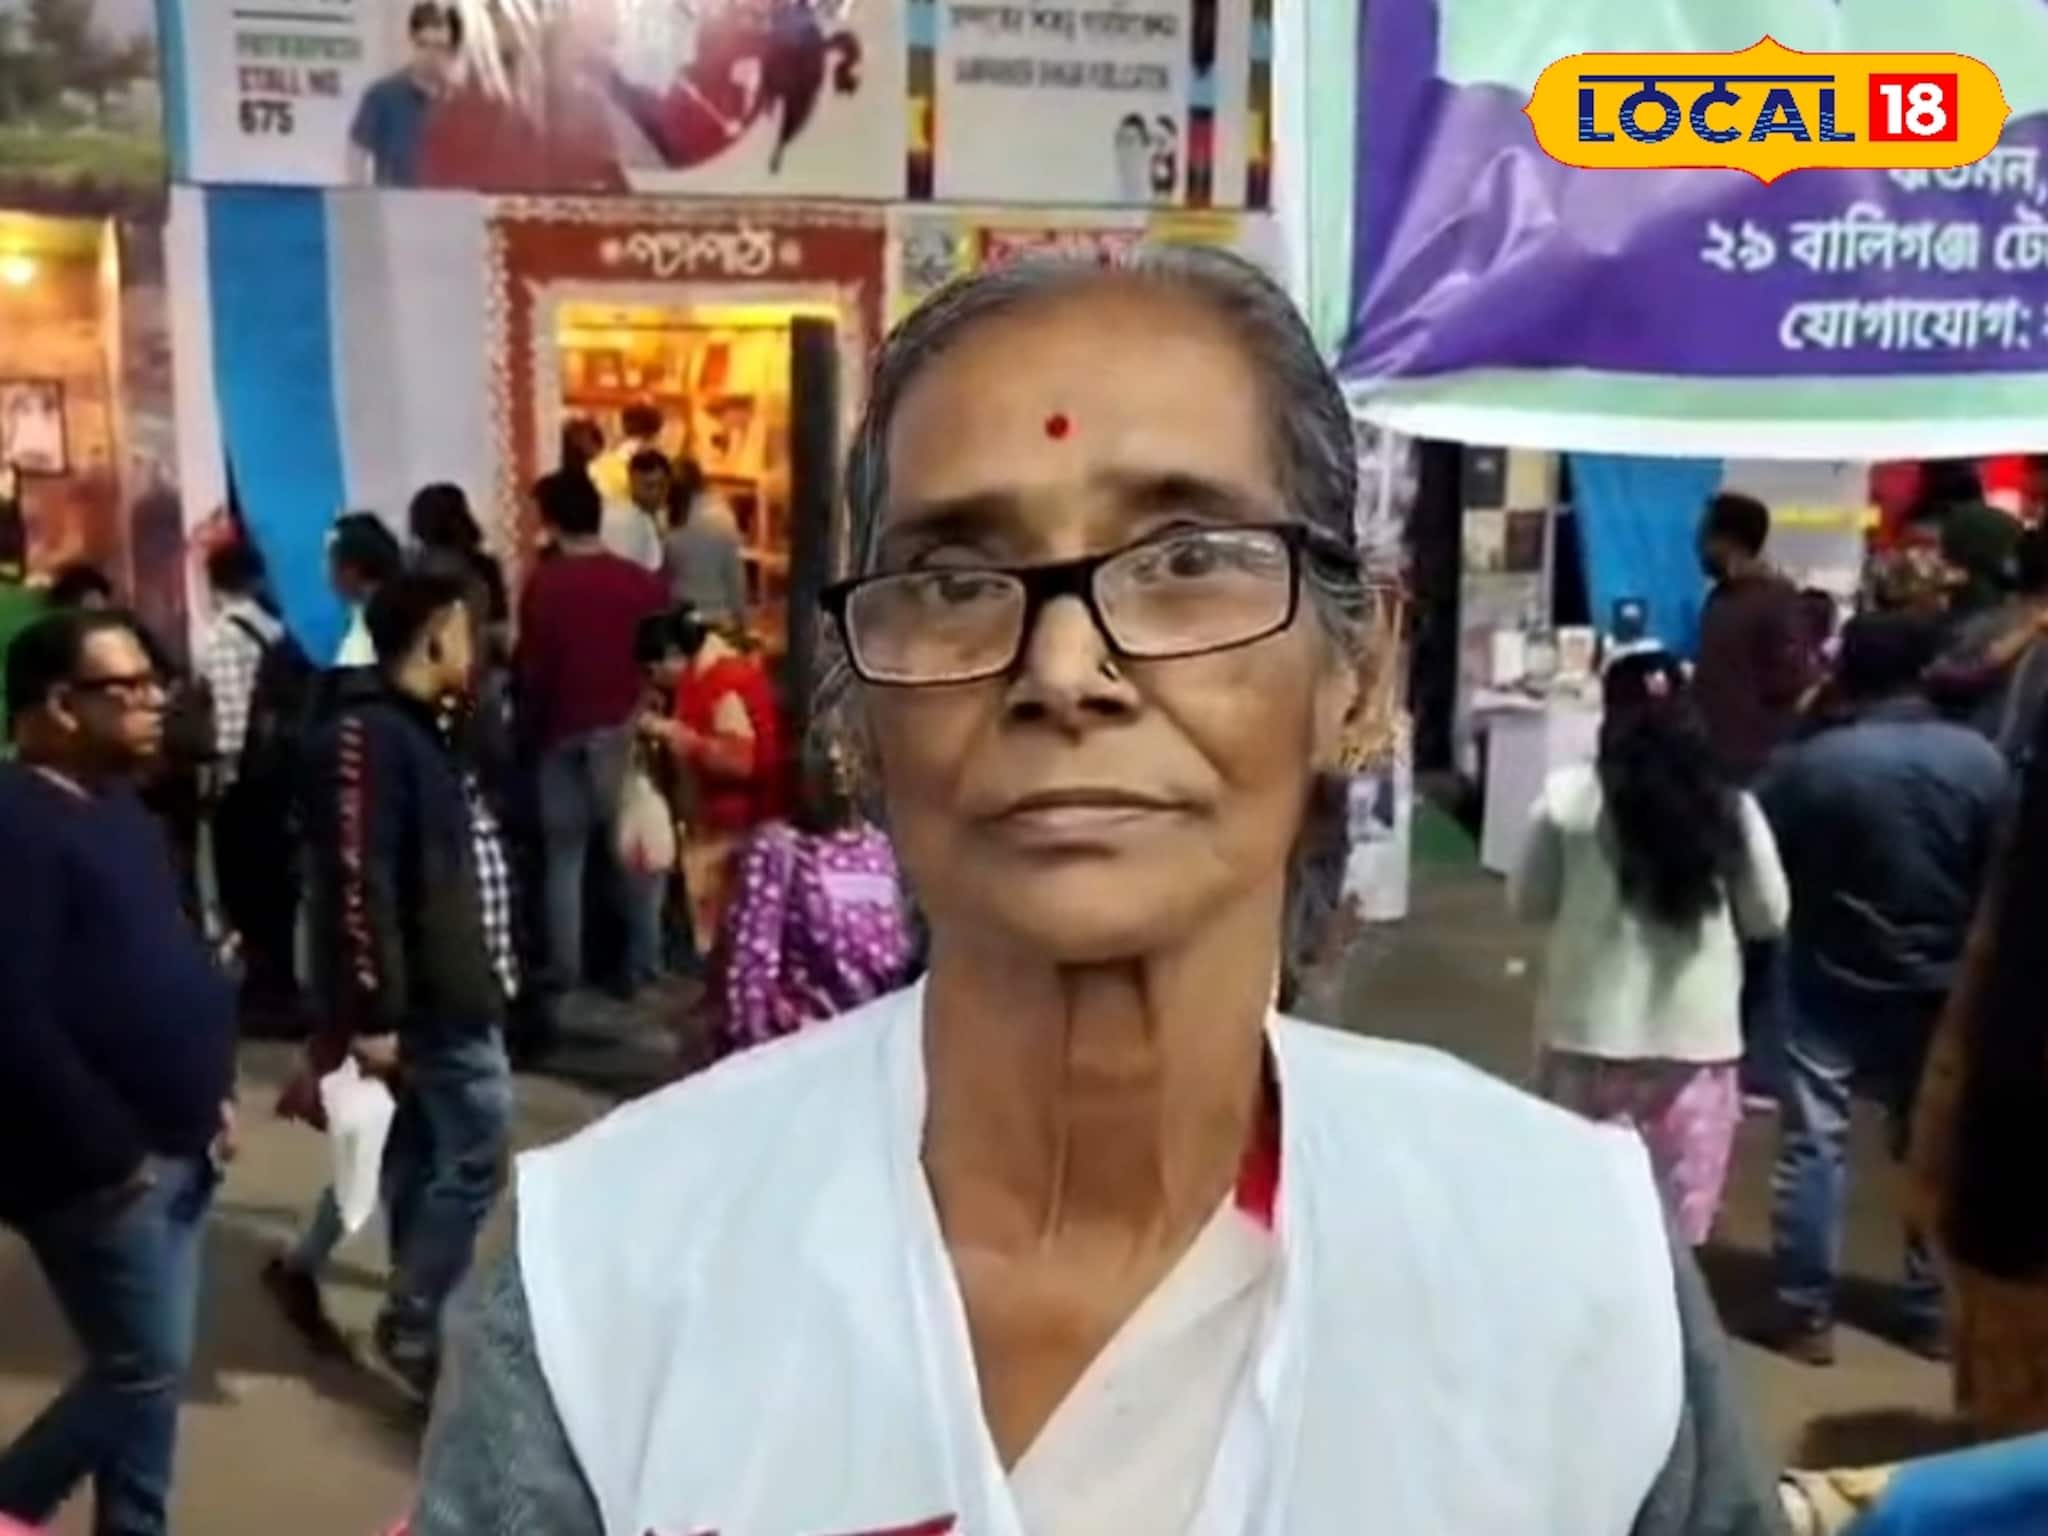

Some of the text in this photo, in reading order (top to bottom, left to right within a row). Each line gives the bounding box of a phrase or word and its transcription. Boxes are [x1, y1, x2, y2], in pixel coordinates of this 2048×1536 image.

[239, 100, 293, 133] 675
[1700, 201, 2048, 271] ২৯ বালিগঞ্জ টে
[1778, 296, 2032, 350] যোগাযোগ:
